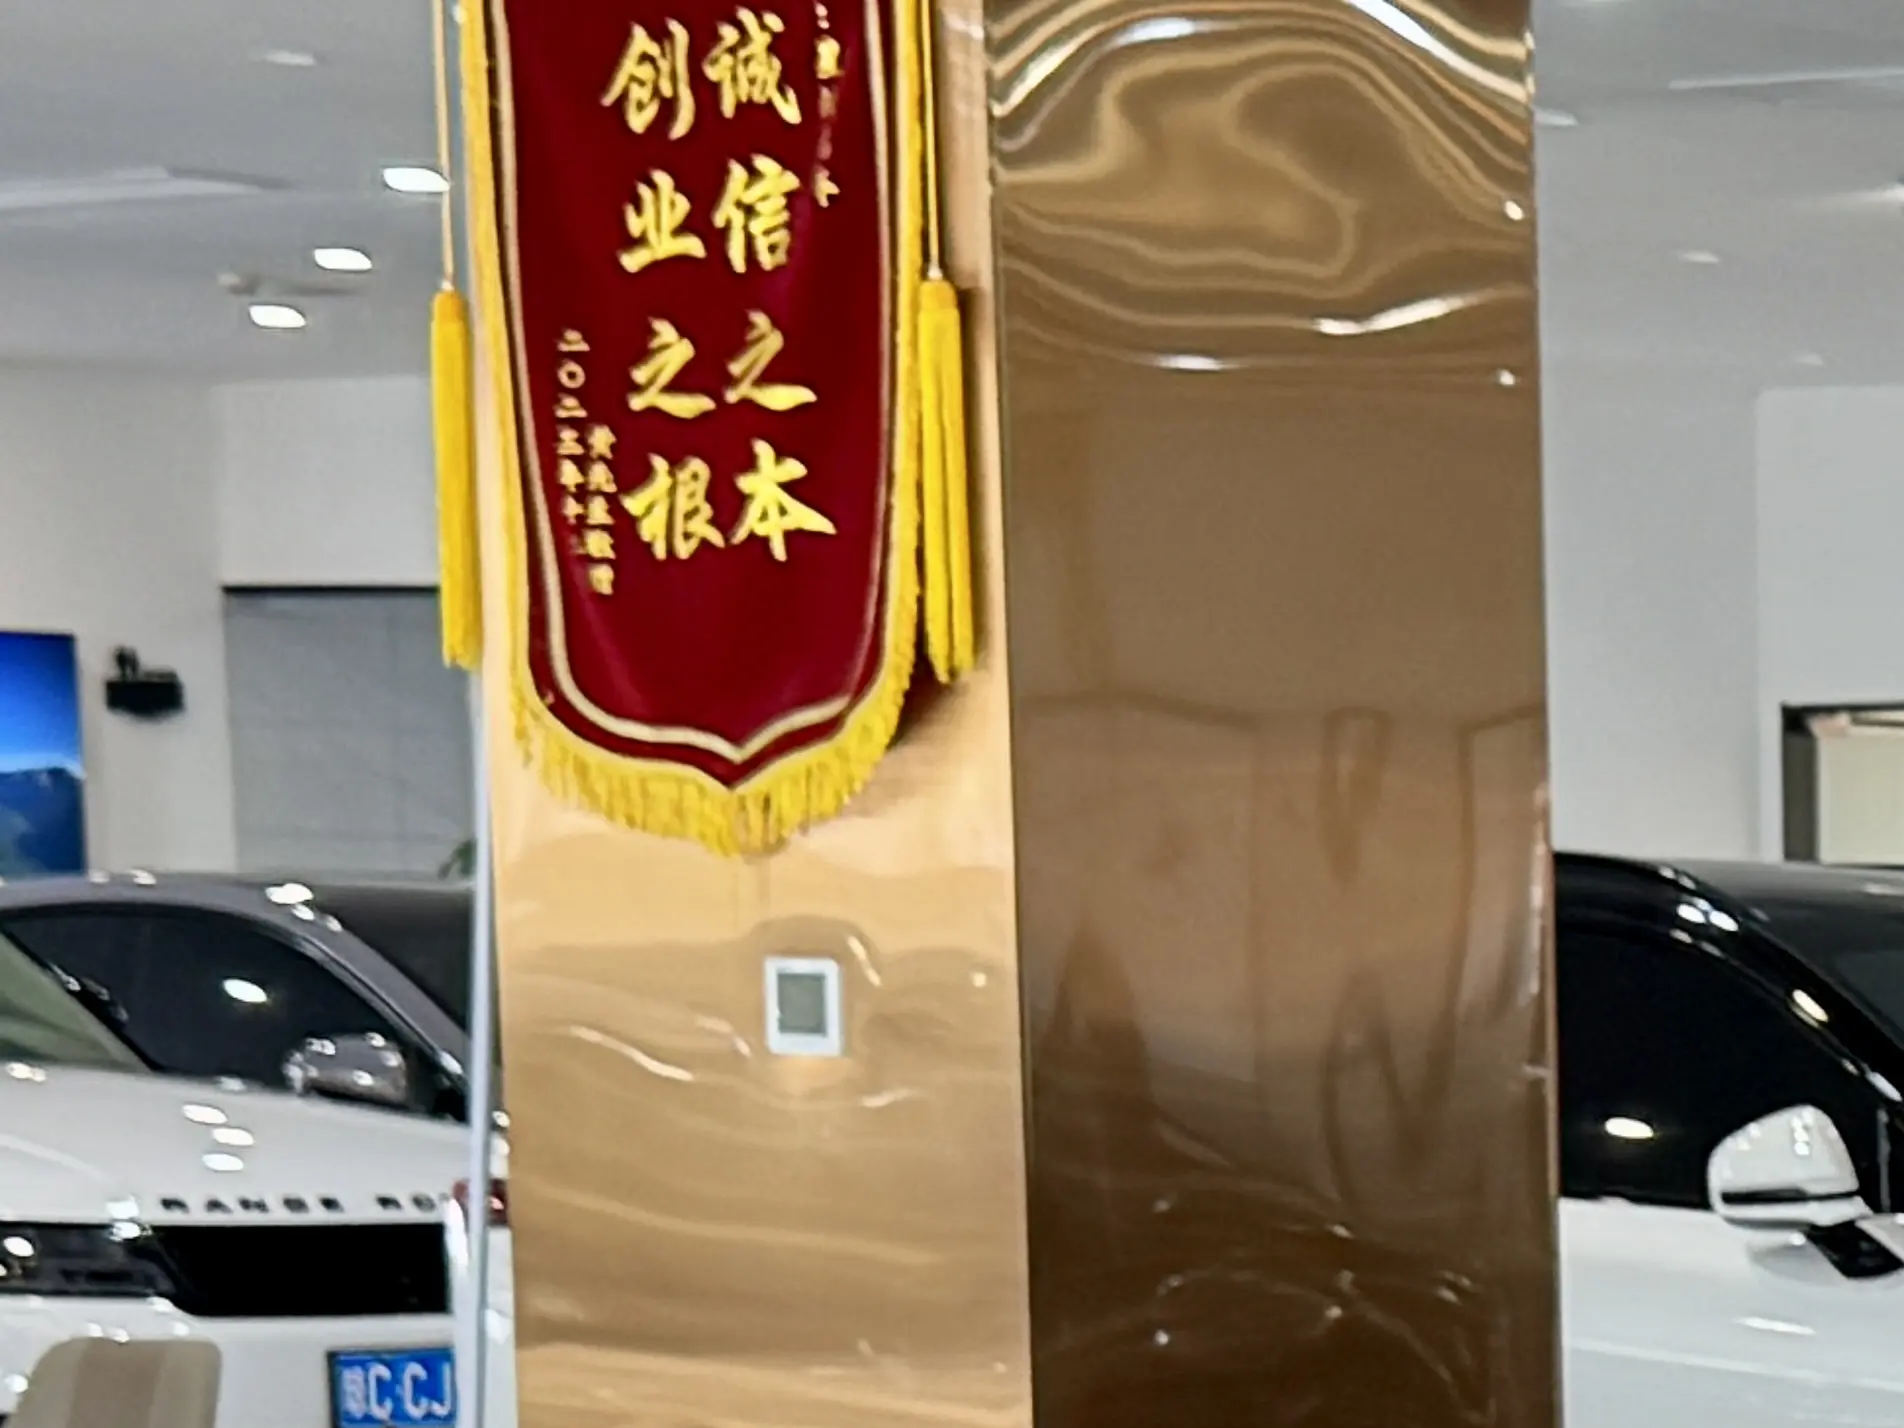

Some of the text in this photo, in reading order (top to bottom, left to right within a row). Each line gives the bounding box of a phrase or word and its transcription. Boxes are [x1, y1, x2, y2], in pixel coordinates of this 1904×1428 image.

[602, 15, 728, 562] 创业之根
[702, 6, 837, 563] 诚信之本
[160, 1193, 449, 1215] RANGE RO
